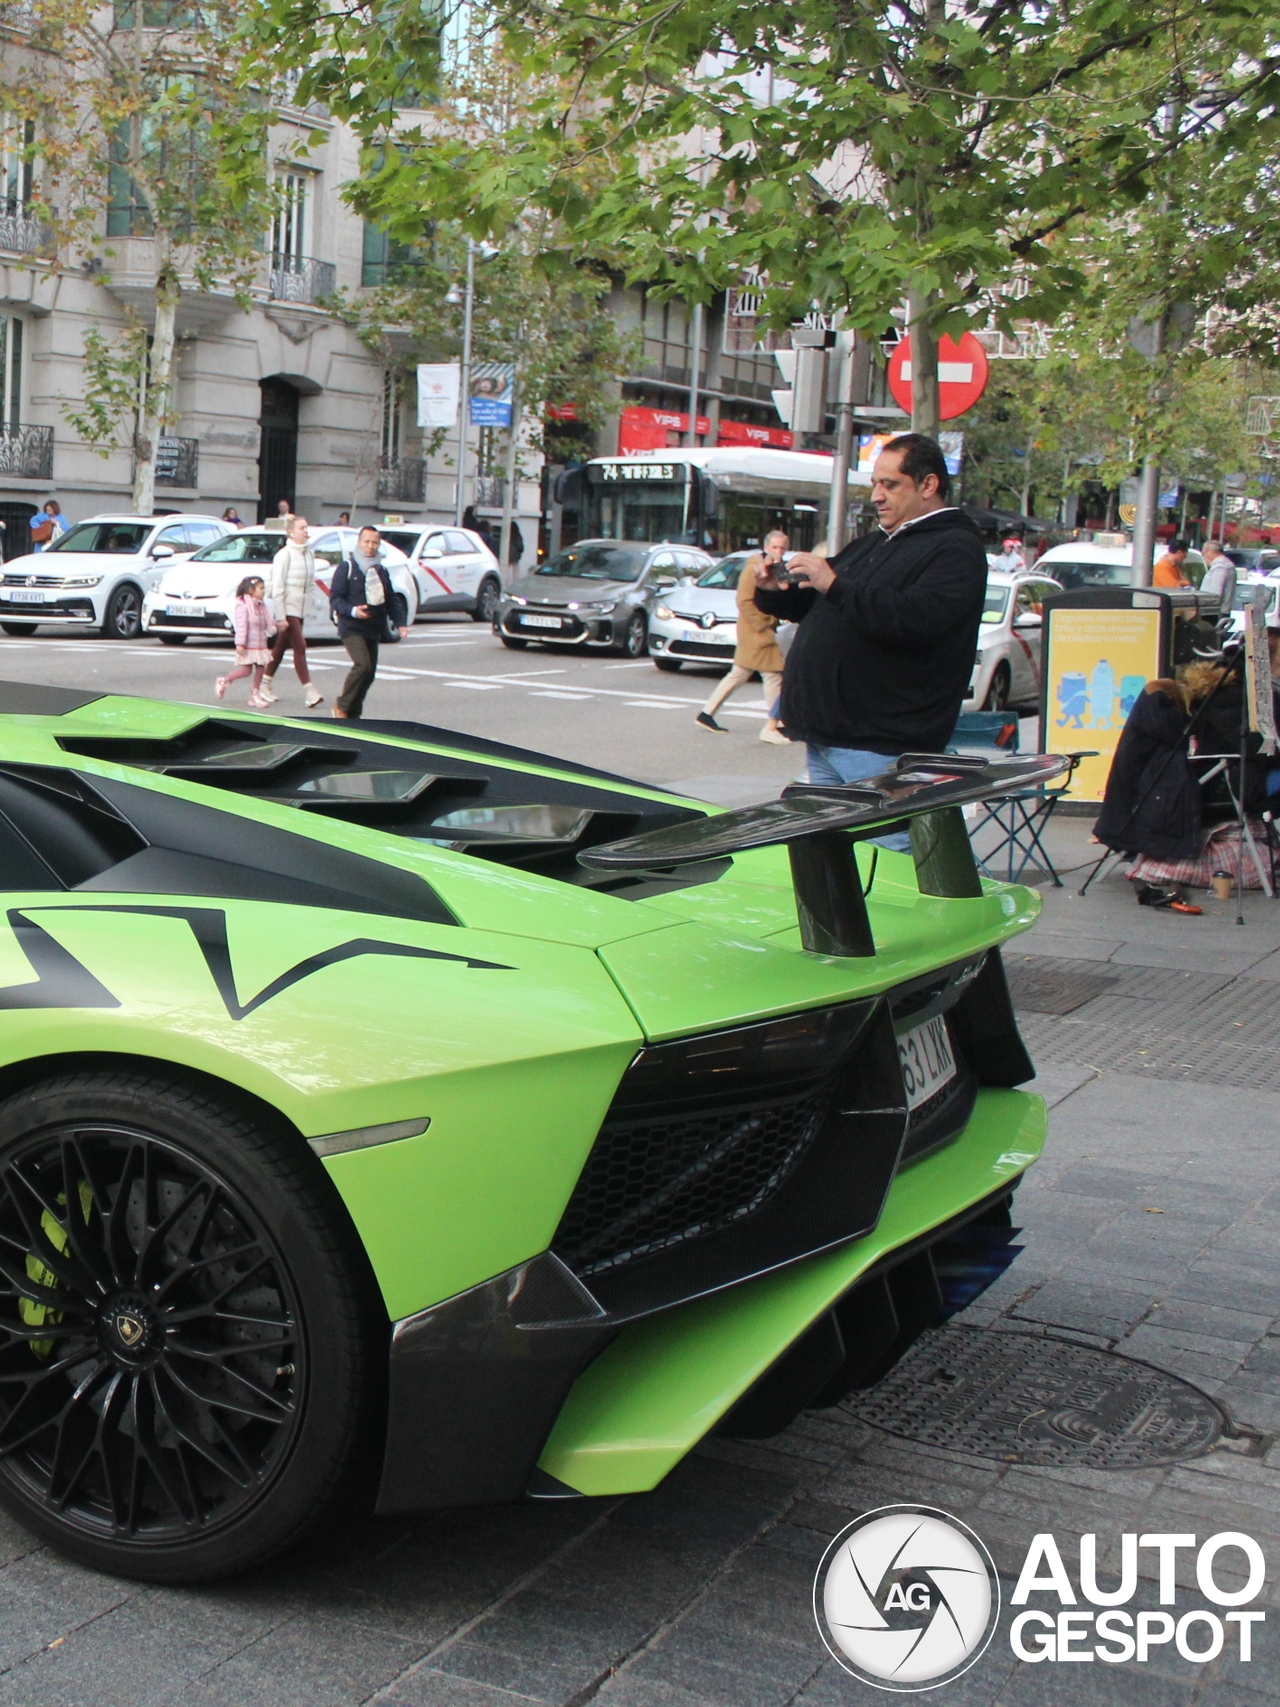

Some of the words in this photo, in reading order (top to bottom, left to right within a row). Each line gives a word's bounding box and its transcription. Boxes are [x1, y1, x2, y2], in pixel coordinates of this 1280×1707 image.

[653, 413, 682, 428] VIPS
[746, 428, 770, 442] VIPS
[601, 464, 619, 481] 74
[897, 1036, 926, 1097] 63
[918, 1015, 953, 1082] LXK
